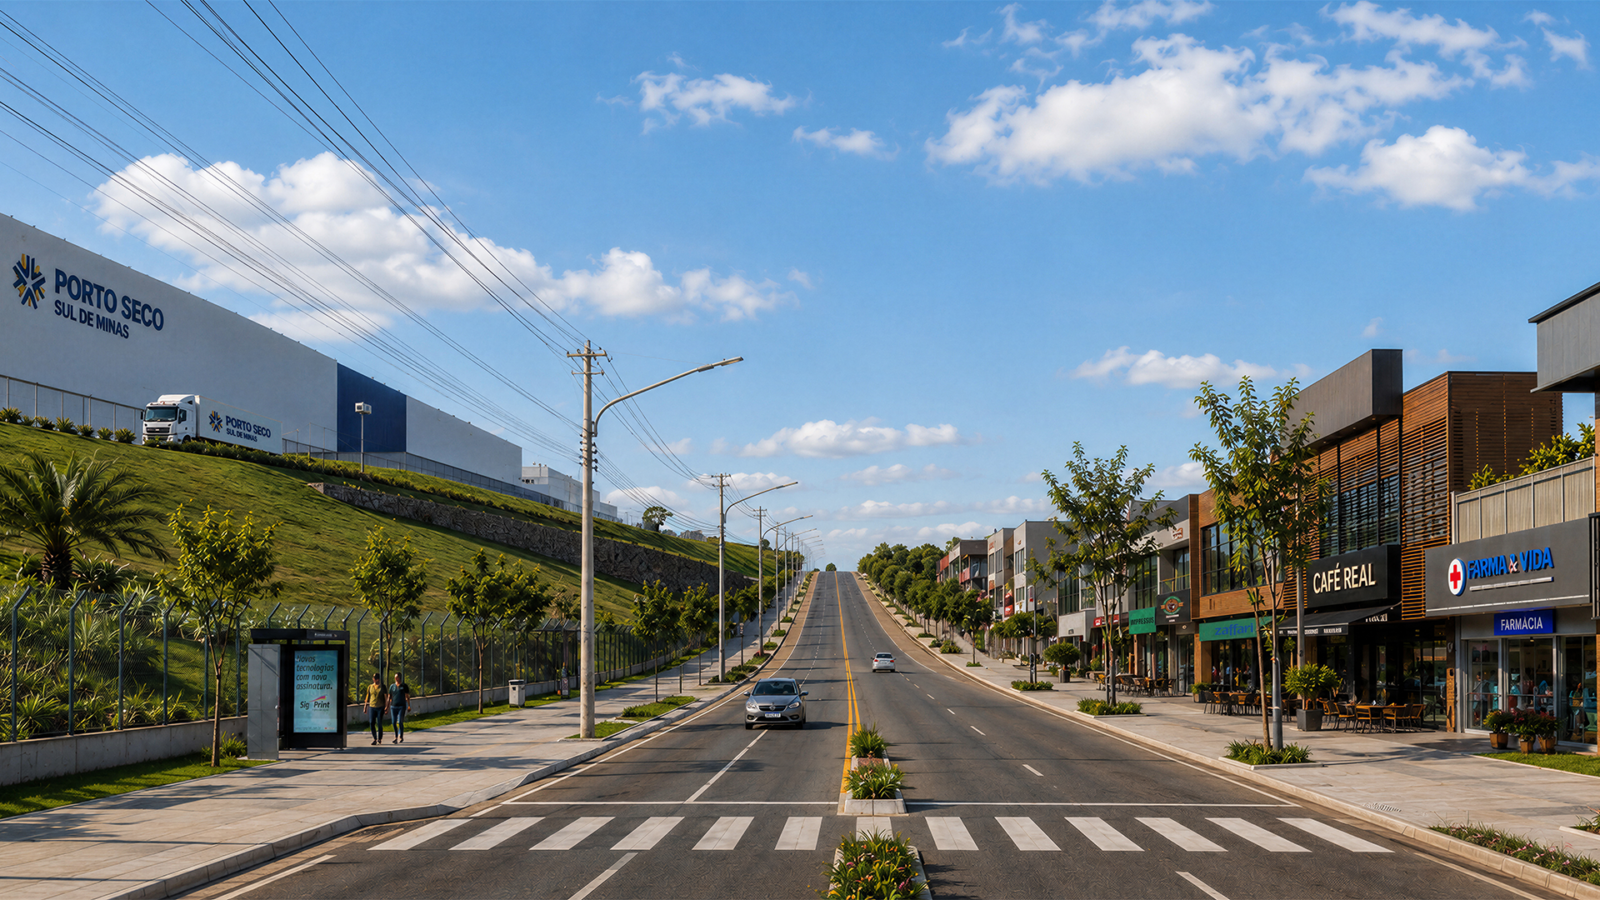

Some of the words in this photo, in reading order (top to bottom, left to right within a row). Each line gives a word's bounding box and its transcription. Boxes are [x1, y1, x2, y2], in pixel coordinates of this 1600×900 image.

[55, 268, 117, 313] PORTO
[121, 295, 164, 331] SECO
[54, 299, 77, 322] SUL
[78, 307, 94, 327] DE
[96, 314, 130, 339] MINAS
[226, 415, 251, 432] PORTO
[252, 424, 271, 438] SECO
[226, 428, 236, 436] SUL
[243, 433, 258, 442] MINAS
[1467, 555, 1508, 579] FARMA
[1508, 553, 1518, 574] &
[1519, 547, 1554, 572] VIDA
[1313, 562, 1341, 594] CAFÉ
[1343, 563, 1376, 590] REAL
[1214, 622, 1254, 636] zaffari
[296, 654, 316, 663] Novas
[296, 663, 334, 674] tecnologias
[296, 681, 333, 690] assinatura.
[300, 700, 310, 710] Sig
[313, 700, 330, 709] Print
